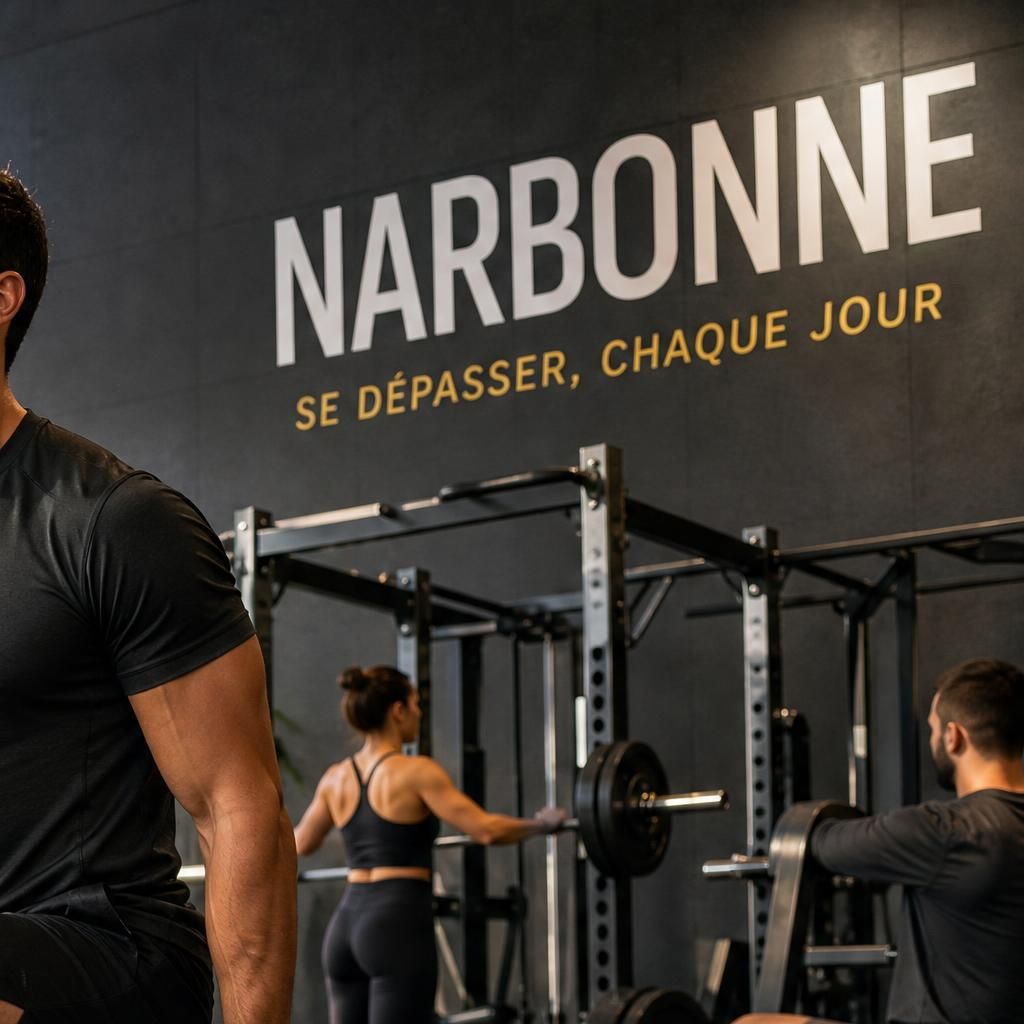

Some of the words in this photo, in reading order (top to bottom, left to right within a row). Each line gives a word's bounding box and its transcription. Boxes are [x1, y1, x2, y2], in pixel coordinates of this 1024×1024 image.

[274, 61, 983, 368] NARBONNE
[295, 391, 340, 431] SE
[358, 350, 581, 420] DÉPASSER,
[601, 309, 789, 378] CHAQUE
[809, 282, 943, 342] JOUR
